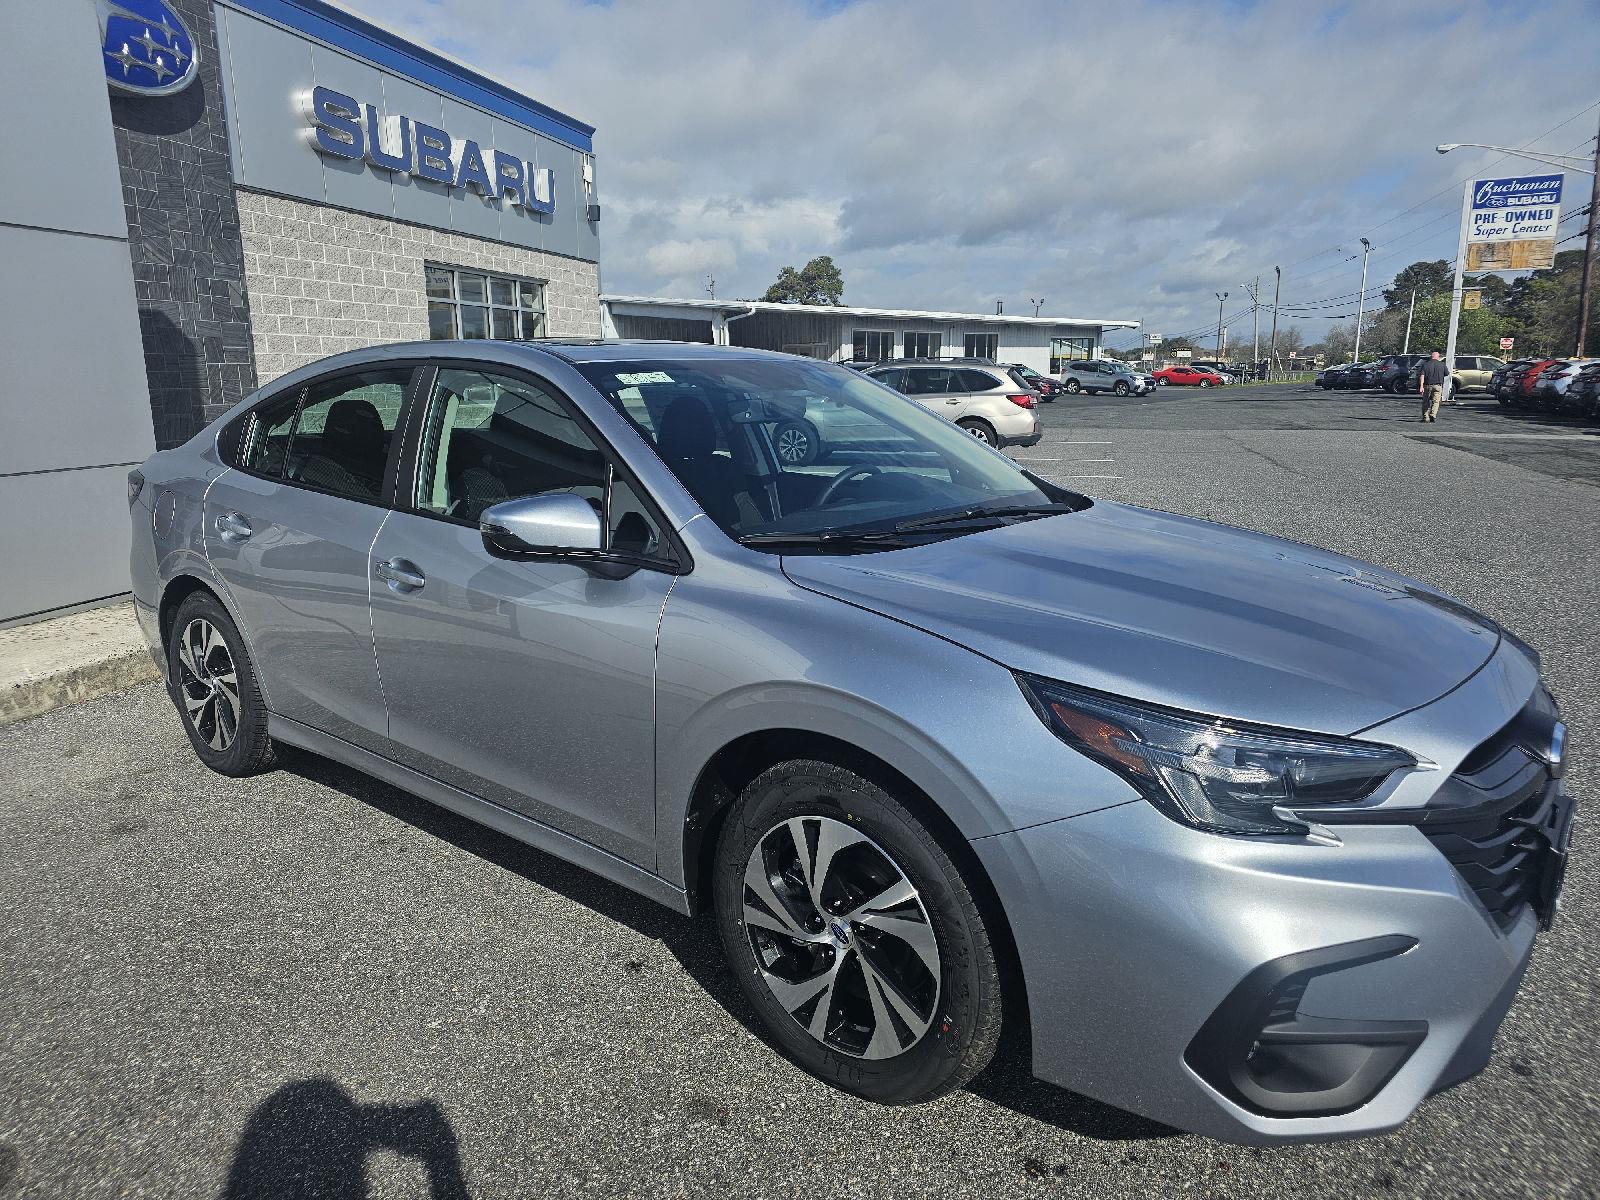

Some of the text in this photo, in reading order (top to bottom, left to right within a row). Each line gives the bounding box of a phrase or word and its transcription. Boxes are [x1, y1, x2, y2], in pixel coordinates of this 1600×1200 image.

[309, 85, 556, 214] SUBARU
[1476, 180, 1560, 203] Buchanan
[1507, 194, 1557, 206] SUBARU
[1474, 222, 1552, 238] Super Center
